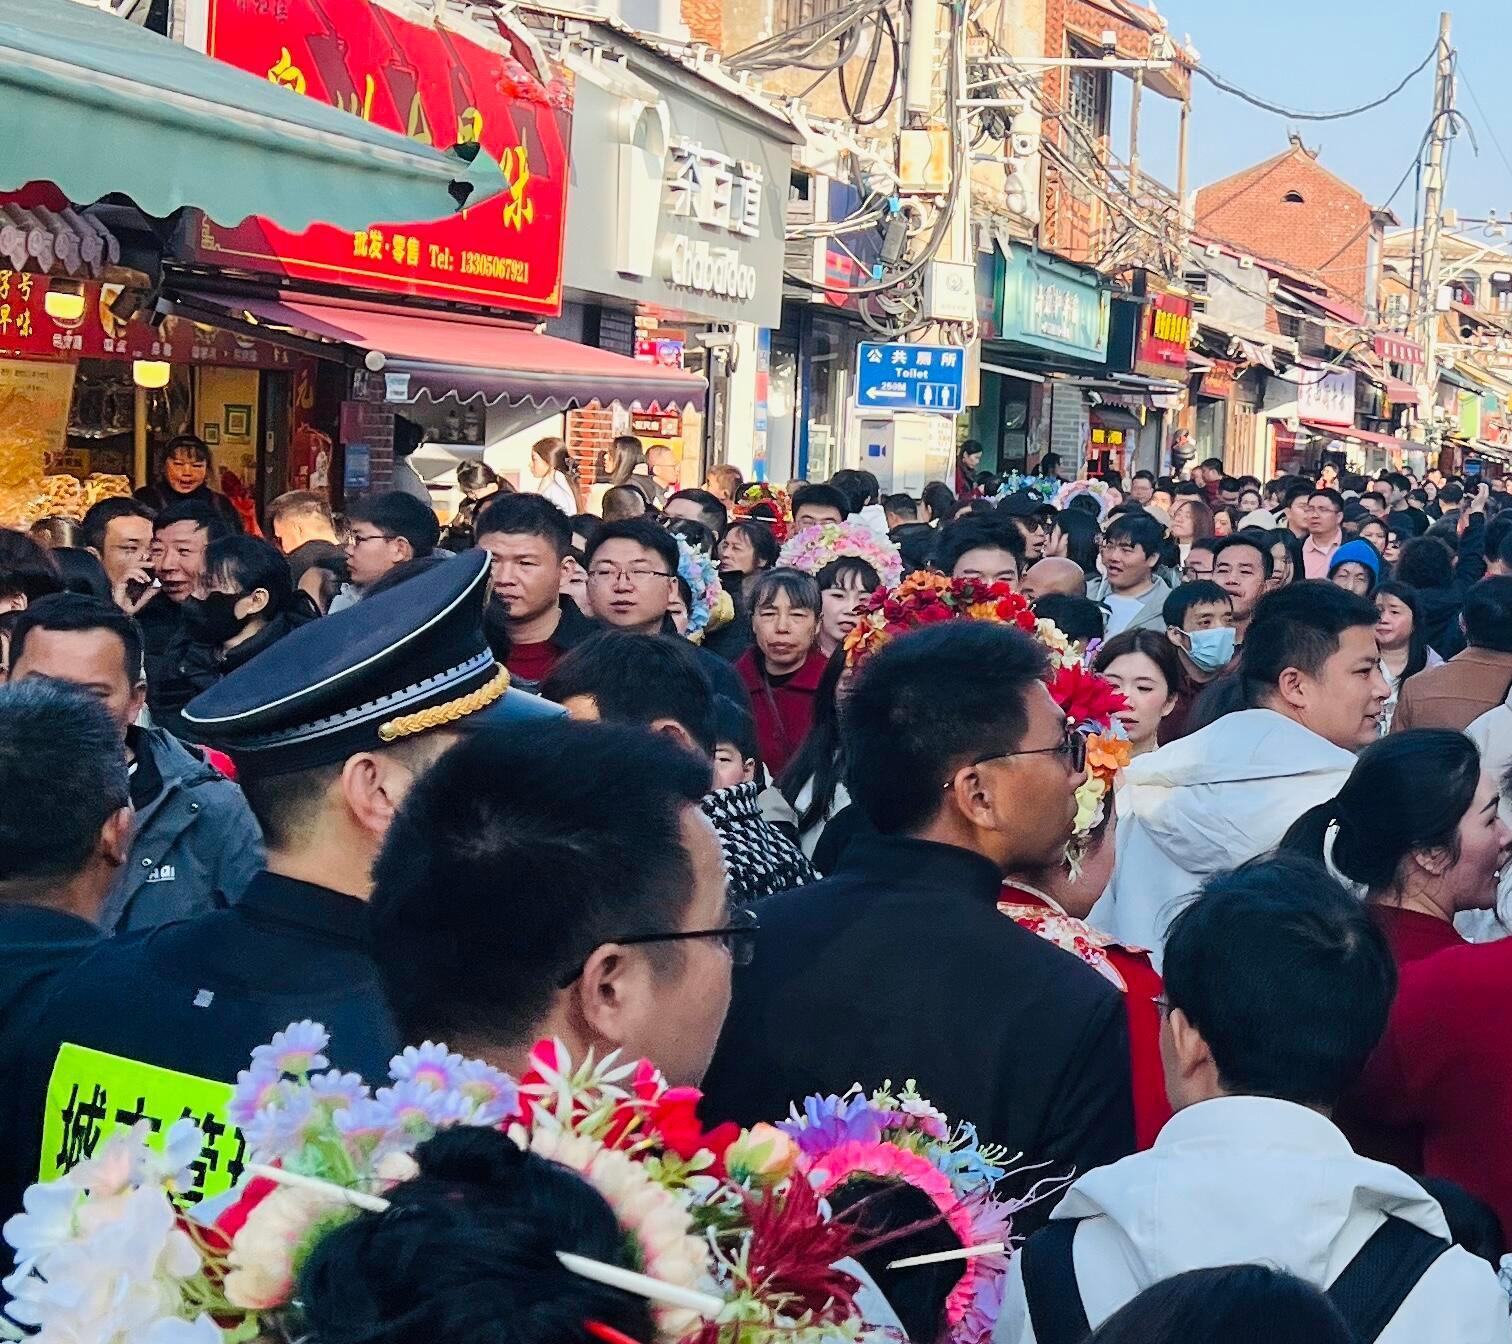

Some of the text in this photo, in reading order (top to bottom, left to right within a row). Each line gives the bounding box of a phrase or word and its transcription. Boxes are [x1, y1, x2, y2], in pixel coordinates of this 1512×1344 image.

[667, 138, 764, 238] 茶百道
[429, 244, 454, 271] Tel:
[895, 367, 929, 379] Toilet
